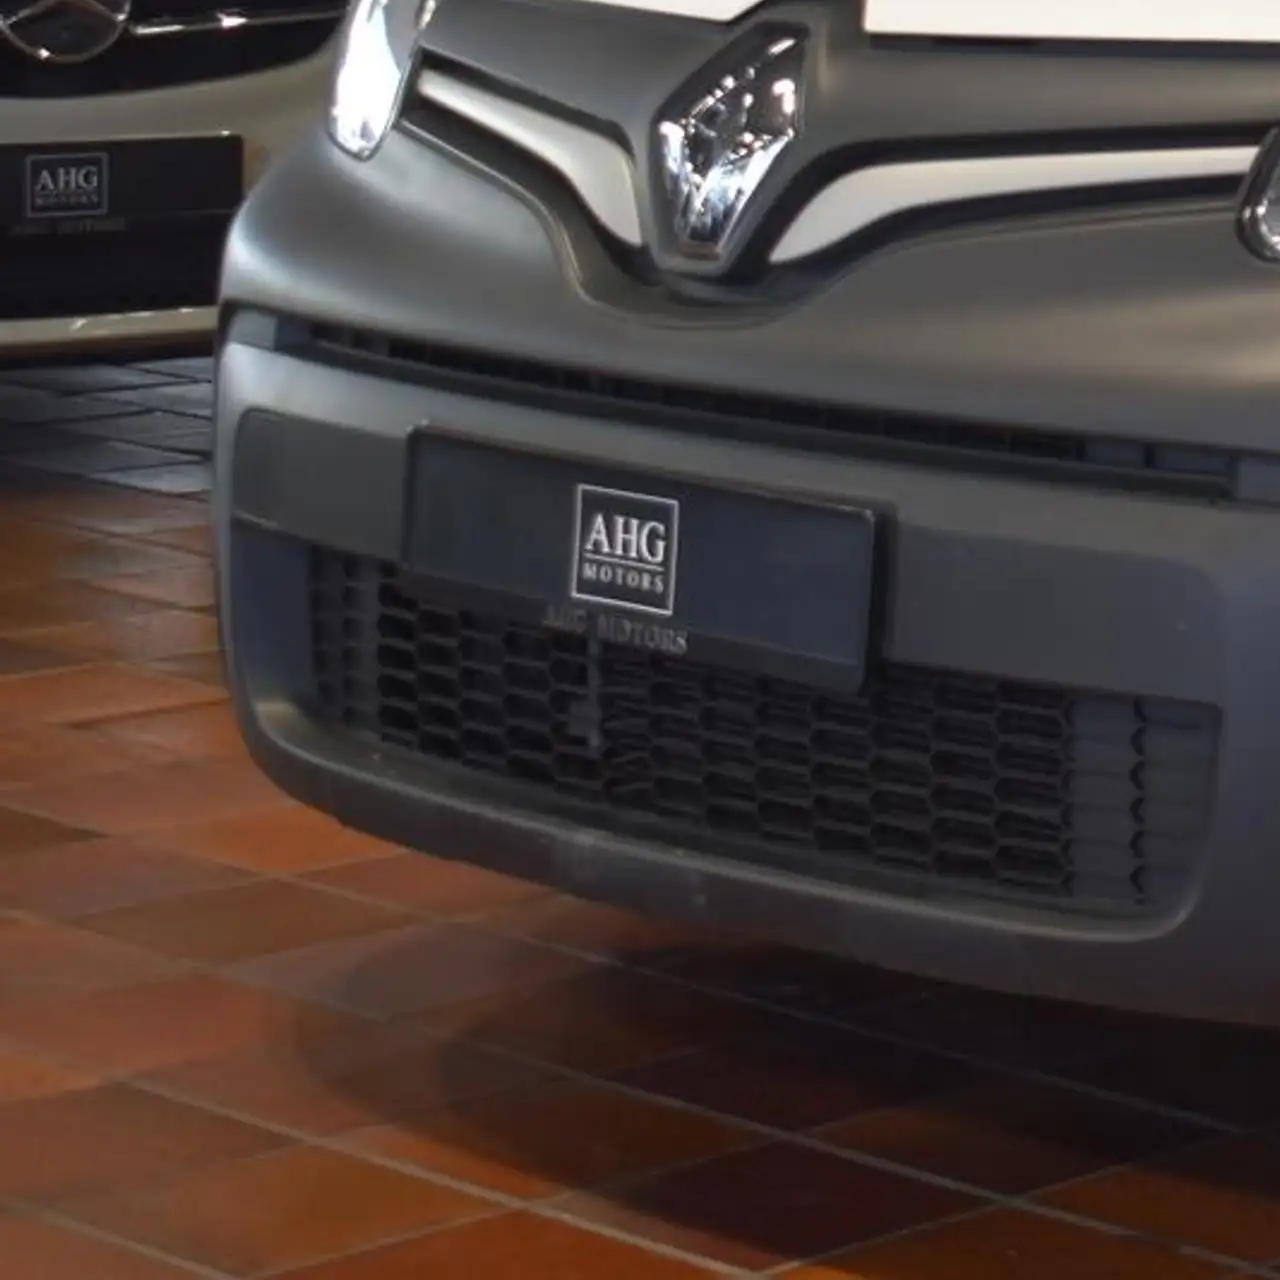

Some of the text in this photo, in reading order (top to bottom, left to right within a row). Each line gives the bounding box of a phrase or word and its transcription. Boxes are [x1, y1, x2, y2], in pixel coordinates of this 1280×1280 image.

[34, 165, 98, 192] AHG
[584, 512, 667, 565] AHG
[581, 562, 665, 595] MOTORS
